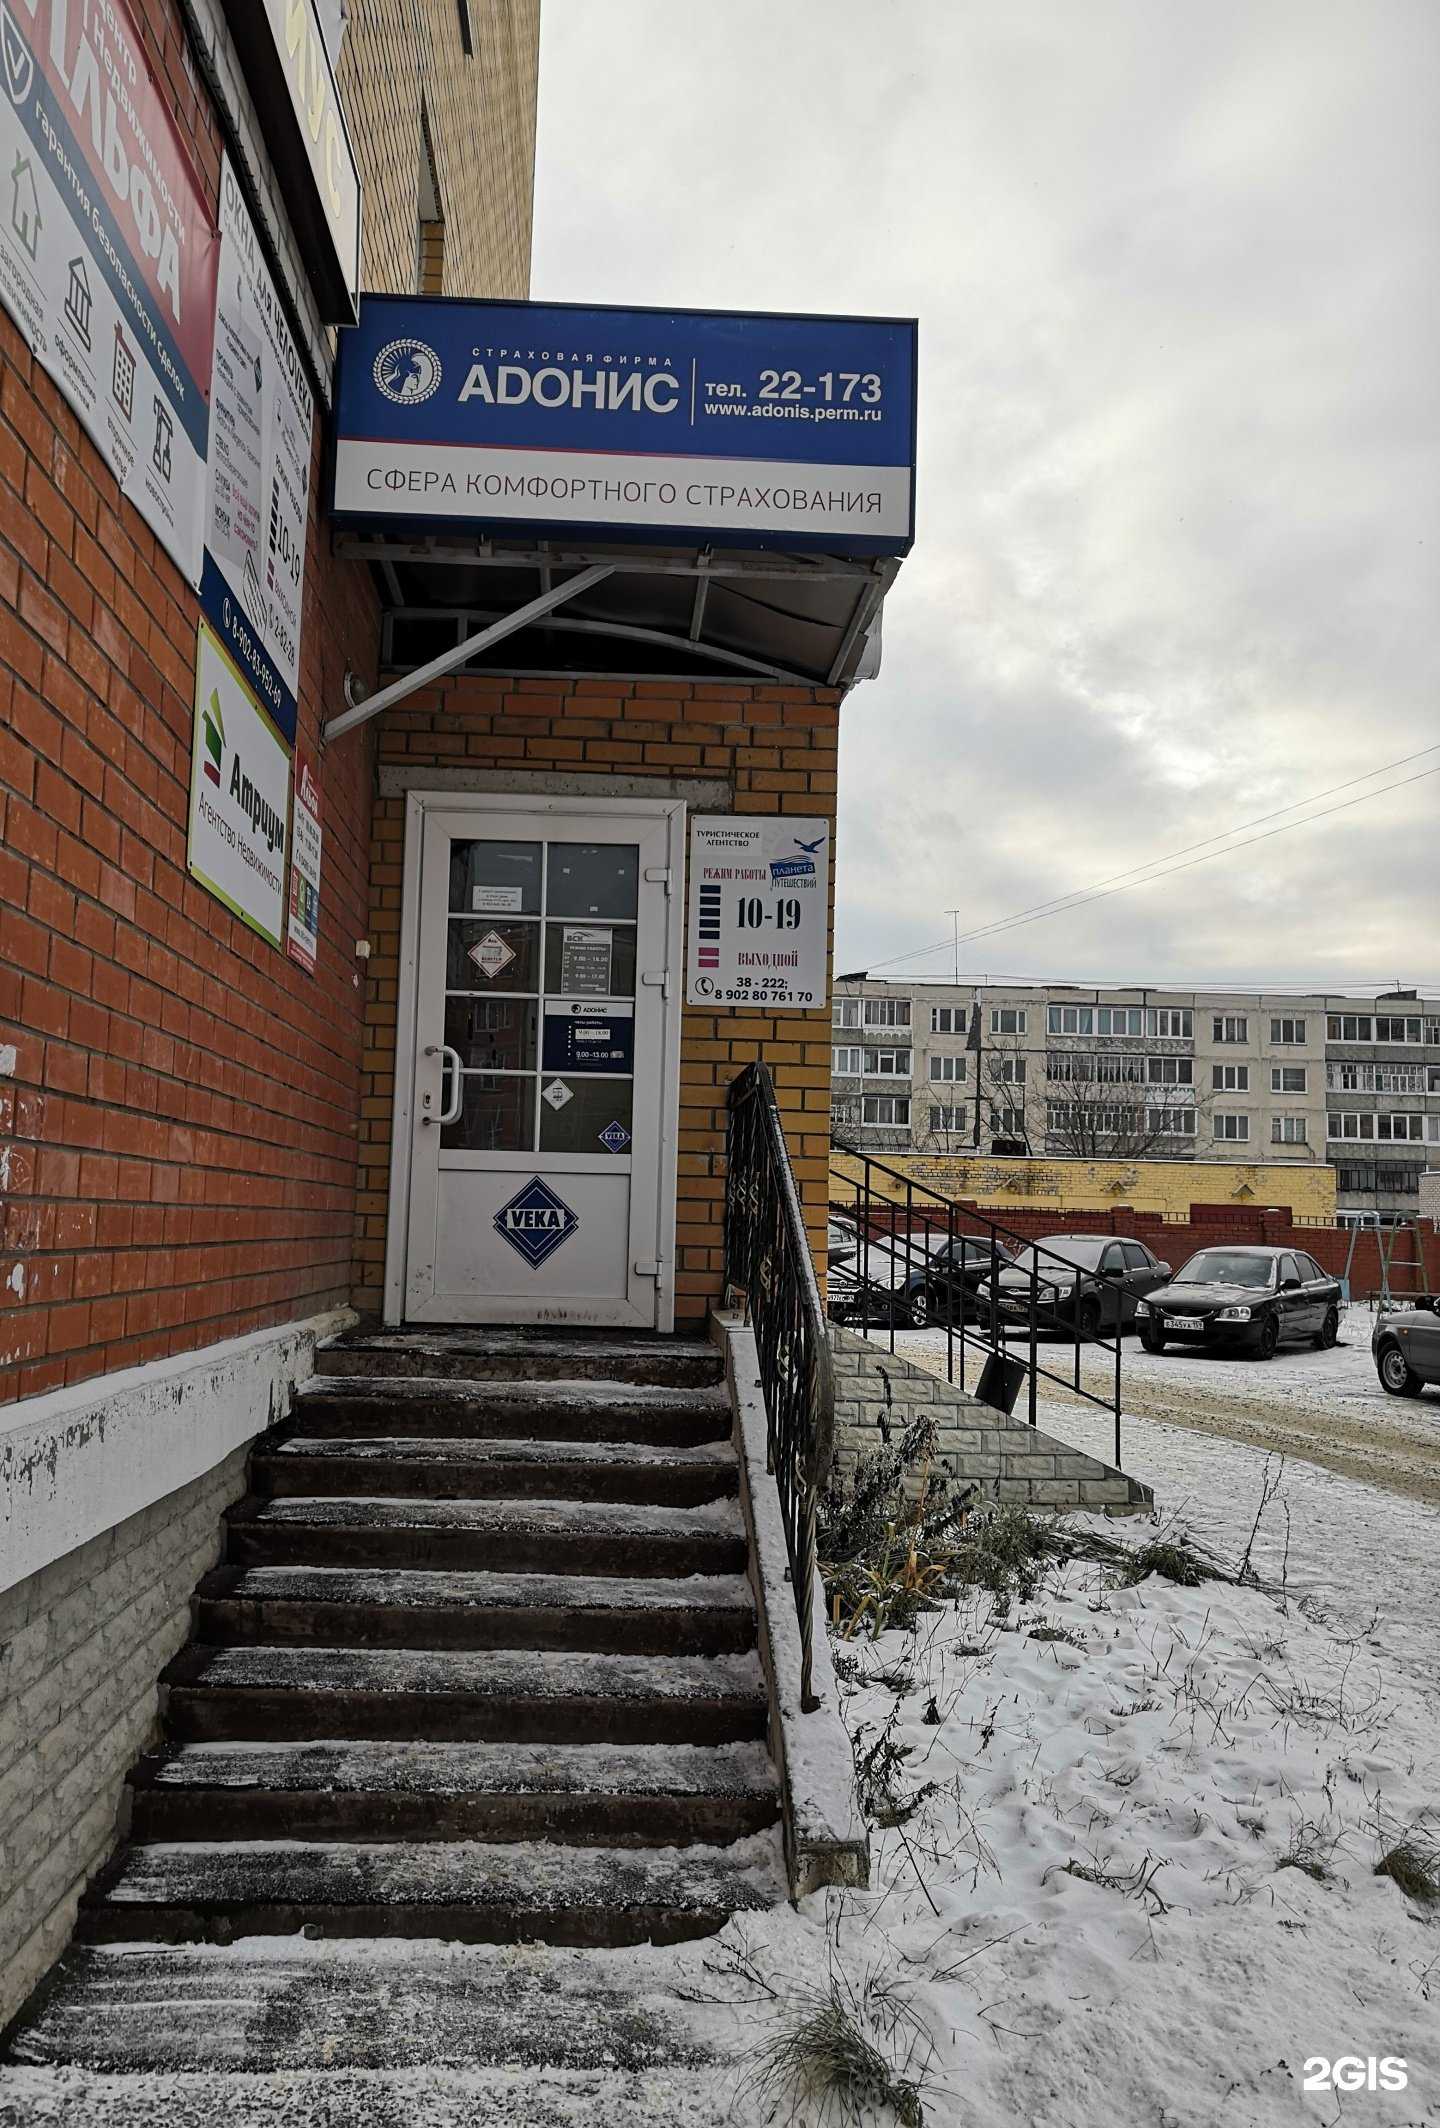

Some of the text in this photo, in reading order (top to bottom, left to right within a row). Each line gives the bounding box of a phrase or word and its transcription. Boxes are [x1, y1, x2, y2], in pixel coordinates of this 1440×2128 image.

[94, 12, 186, 245] Недвижимости
[225, 170, 255, 275] ОКНА
[35, 100, 185, 401] гарантия безопасности сделок
[472, 348, 672, 367] СТРАХОВАЯ ФИРМА
[705, 370, 882, 403] тел. 22-173
[705, 403, 882, 422] www.adonis.perm.ru
[366, 467, 882, 514] СФЕРА КОМФОРТНОГО СТРАХОВАНИЯ
[278, 515, 300, 588] 10-19
[232, 615, 282, 710] 8-902-83-952-69
[230, 753, 284, 856] Атриум
[199, 791, 236, 857] Агентство
[237, 831, 282, 897] Недвижимости
[697, 831, 760, 839] ТУРИСТИЧЕСКОЕ
[704, 867, 766, 880] РЕЖИМ РАБОТЫ
[773, 864, 814, 876] планета
[736, 897, 800, 930] 10-19
[737, 950, 798, 970] ВЫХОДНОЙ
[714, 989, 813, 1001] 8 902 80 761 70
[736, 977, 752, 988] 38
[511, 1210, 561, 1228] VEKA
